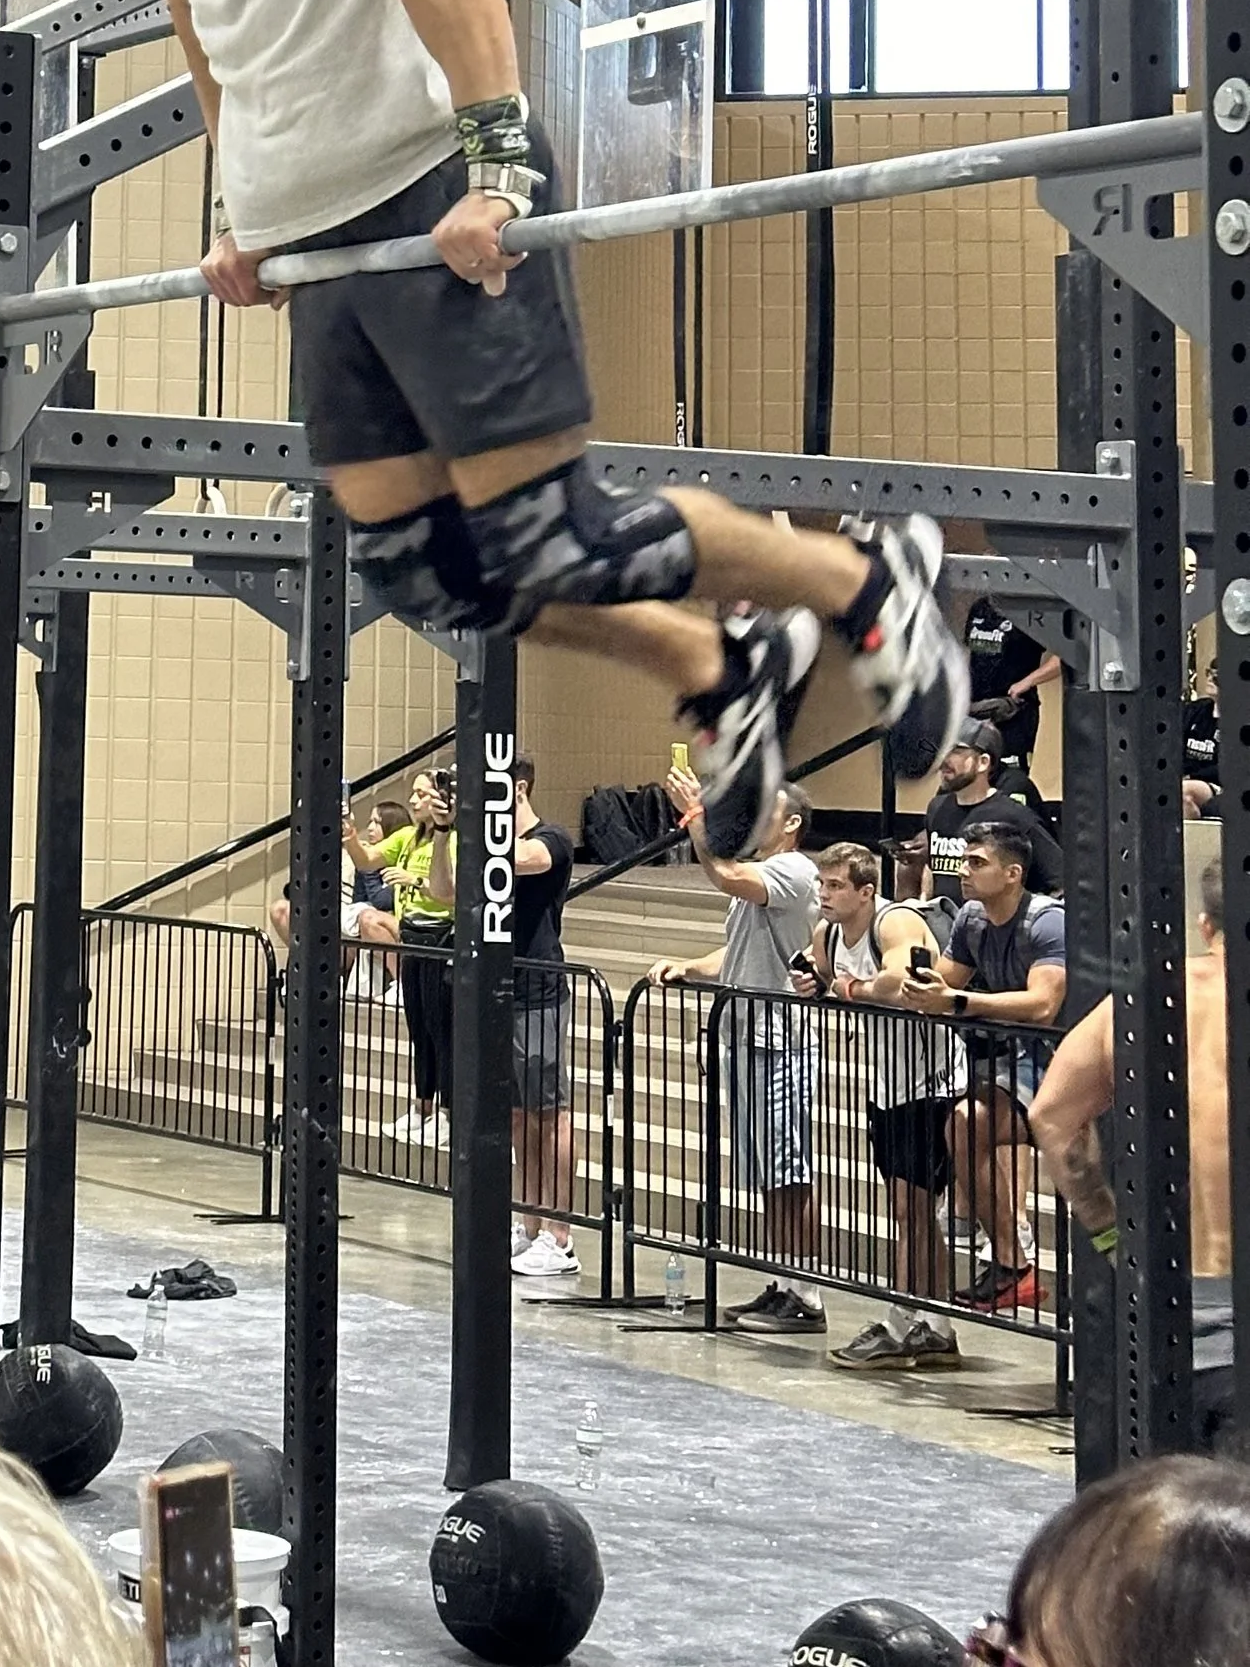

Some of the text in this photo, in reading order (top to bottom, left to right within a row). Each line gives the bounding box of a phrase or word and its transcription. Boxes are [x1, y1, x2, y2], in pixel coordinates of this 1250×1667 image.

[808, 84, 817, 154] ROGUE
[676, 402, 685, 447] ROG
[483, 733, 513, 943] ROGUE
[931, 831, 968, 857] Cross
[37, 1343, 52, 1385] GUE
